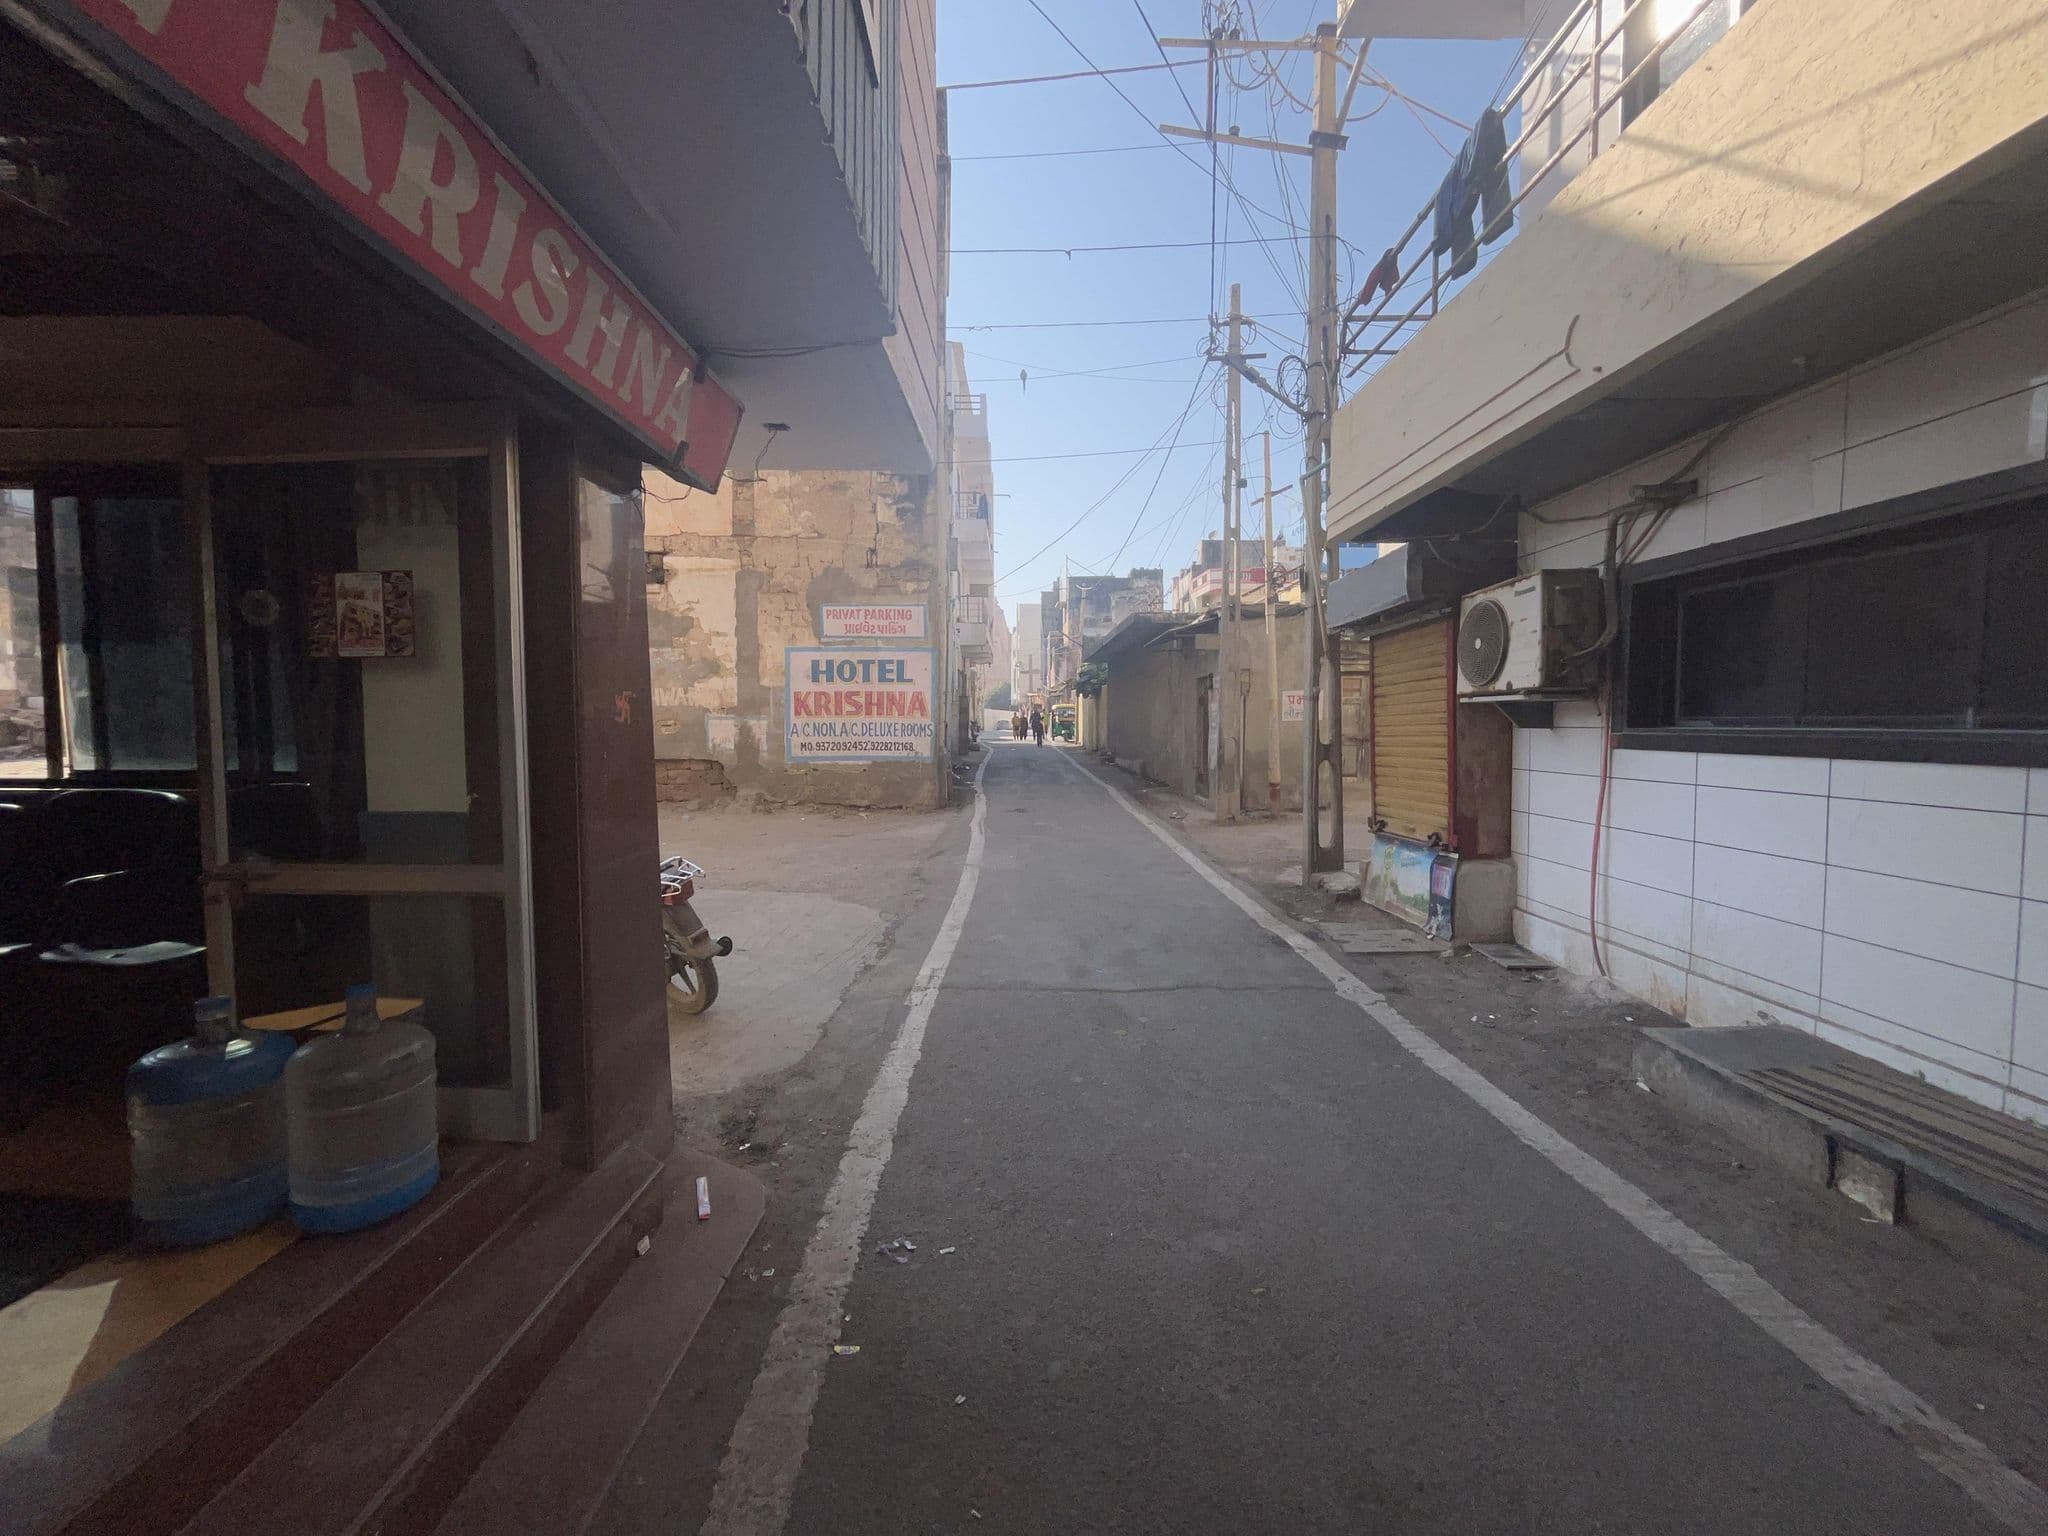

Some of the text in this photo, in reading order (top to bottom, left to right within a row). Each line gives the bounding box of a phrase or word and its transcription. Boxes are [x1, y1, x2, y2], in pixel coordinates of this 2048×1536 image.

[245, 0, 696, 443] KRISHNA
[826, 608, 913, 621] PRIVAT PARKING
[810, 659, 914, 683] HOTEL
[793, 690, 929, 717] KRISHNA
[900, 723, 934, 738] ROOMS
